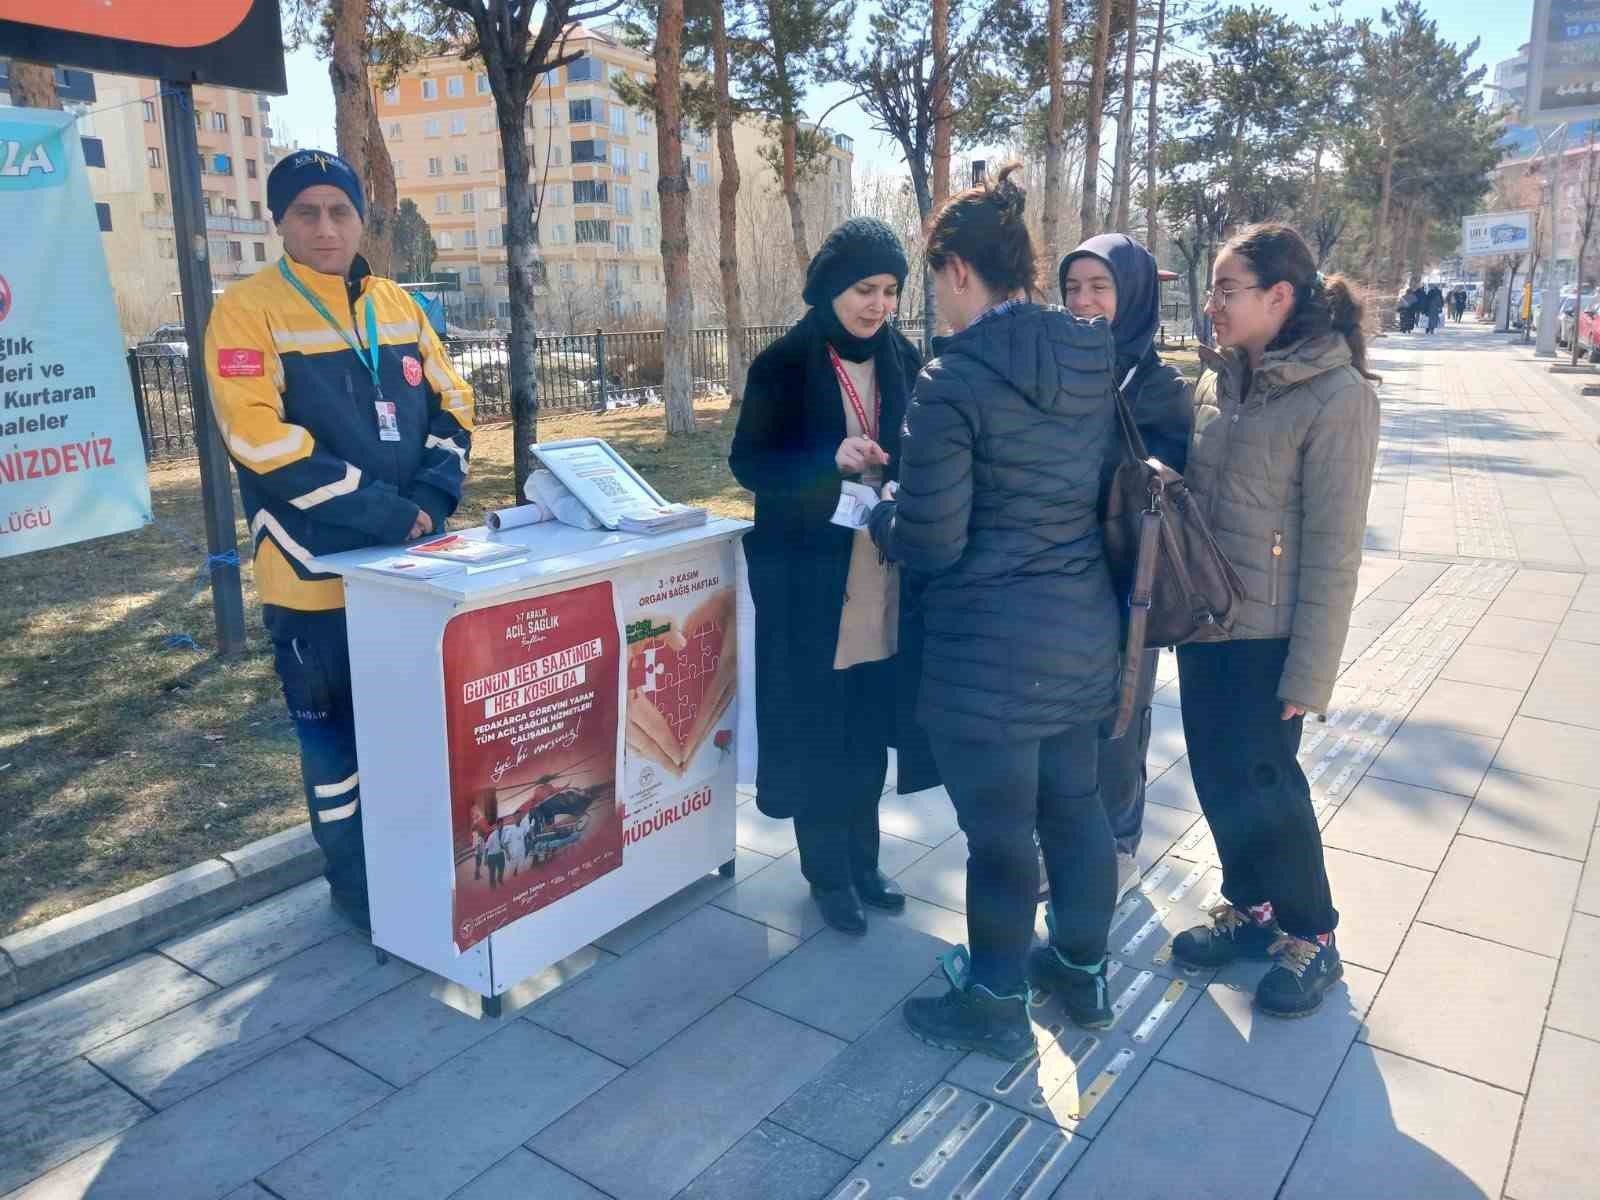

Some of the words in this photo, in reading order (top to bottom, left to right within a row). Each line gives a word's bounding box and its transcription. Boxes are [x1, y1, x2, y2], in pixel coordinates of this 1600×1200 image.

[40, 363, 64, 378] ve
[5, 385, 96, 409] Kurtaran
[638, 591, 668, 607] ORGAN
[465, 671, 510, 702] GÜNÜN
[514, 662, 538, 684] HER
[494, 692, 520, 713] HER
